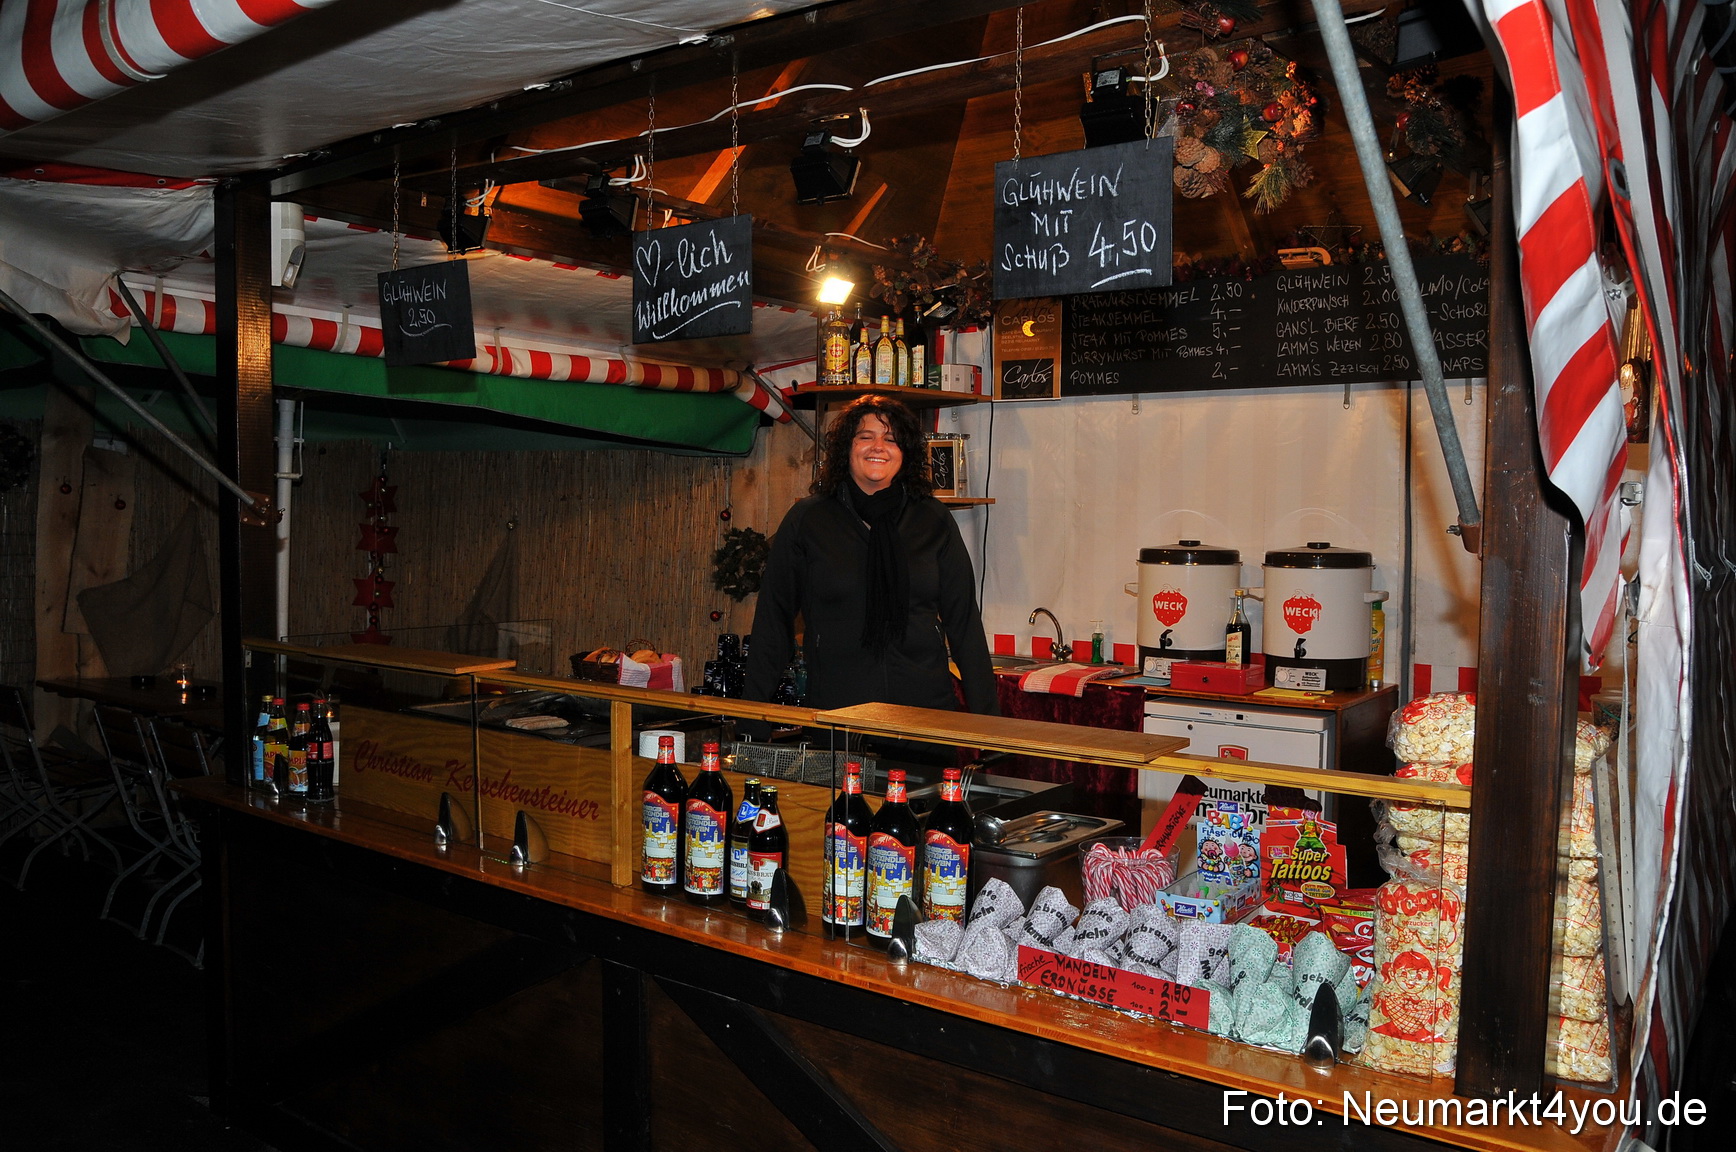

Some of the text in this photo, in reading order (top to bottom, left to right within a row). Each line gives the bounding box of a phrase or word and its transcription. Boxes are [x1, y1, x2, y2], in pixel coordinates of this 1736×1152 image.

[1001, 163, 1124, 208] GLÜHWEIN
[1033, 209, 1074, 239] MIT
[1089, 220, 1157, 268] 4,50
[1276, 266, 1394, 292] GLÜHWEIN 2,5
[383, 278, 447, 304] GLÜHWEIN
[635, 269, 751, 332] Willkommen
[1071, 282, 1243, 312] BRATWURSTSEMMEL 2,50
[1276, 294, 1350, 316] KINDERPUNSCH
[408, 307, 437, 328] 2,50
[1071, 310, 1163, 329] STEAKSEMMEL
[1324, 316, 1359, 333] BIERE
[1365, 313, 1399, 329] 2,50
[1071, 332, 1107, 350] STEAK
[1114, 331, 1132, 345] MIT
[1136, 327, 1189, 343] POMMES
[1326, 335, 1362, 352] WEIZEN
[1369, 332, 1403, 351] 2,80
[1071, 350, 1145, 366] CURRYWURST
[1152, 348, 1172, 361] MIT
[1176, 345, 1213, 359] POMMES
[1383, 355, 1410, 371] 2,50
[1003, 359, 1055, 389] Carlos
[1070, 369, 1120, 386] POMMES
[1154, 600, 1183, 611] WECK
[353, 739, 434, 783] Christian
[1207, 810, 1252, 830] BABY
[1290, 848, 1327, 863] Super
[1270, 859, 1332, 881] Tattoos
[1019, 954, 1046, 977] frische
[1054, 955, 1117, 983] MANDELN
[1131, 981, 1147, 991] 100
[1160, 983, 1191, 1004] 2,50
[1041, 970, 1118, 1002] ERDNÜSSE
[1130, 1001, 1144, 1009] 100
